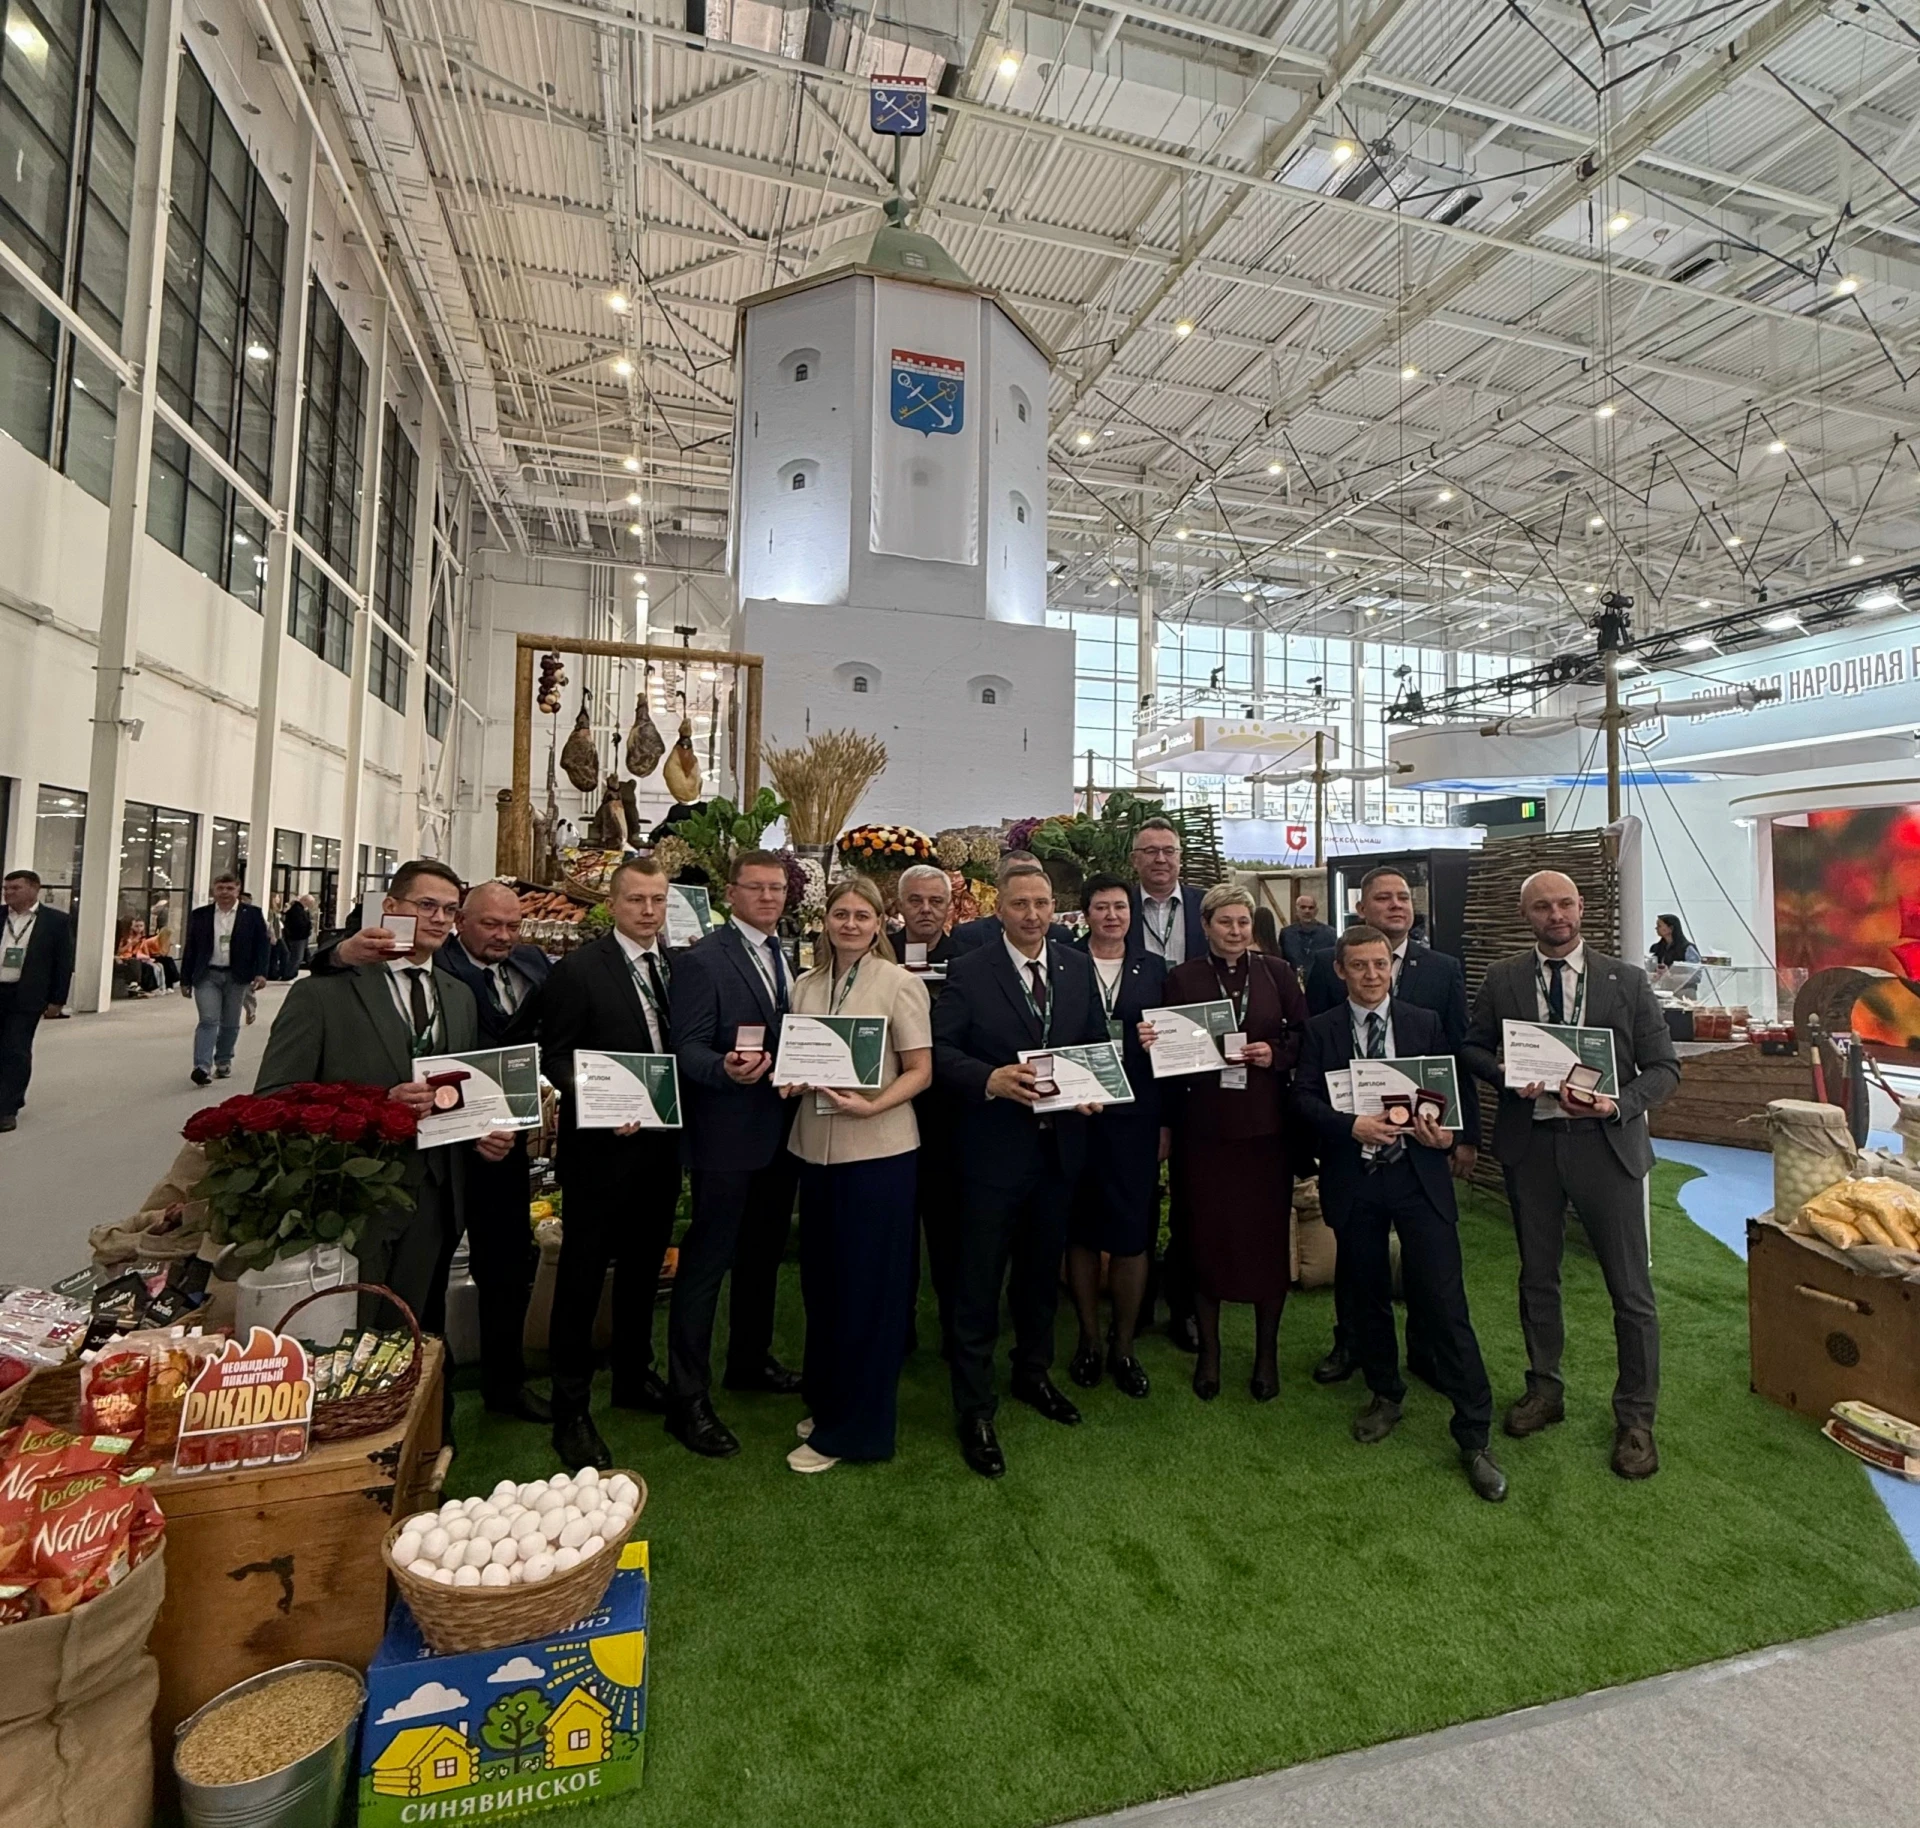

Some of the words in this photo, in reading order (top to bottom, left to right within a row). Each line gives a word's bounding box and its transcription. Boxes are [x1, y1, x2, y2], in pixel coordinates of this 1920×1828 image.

[1789, 648, 1904, 701] НАРОДНАЯ
[221, 1356, 289, 1374] НЕОЖИДАННО
[222, 1369, 284, 1387] ПИКАНТНЫЙ
[185, 1380, 310, 1431] PIKADOR
[40, 1476, 107, 1513] Lorenz
[401, 1768, 602, 1824] СИНЯВИНСКОЕ
